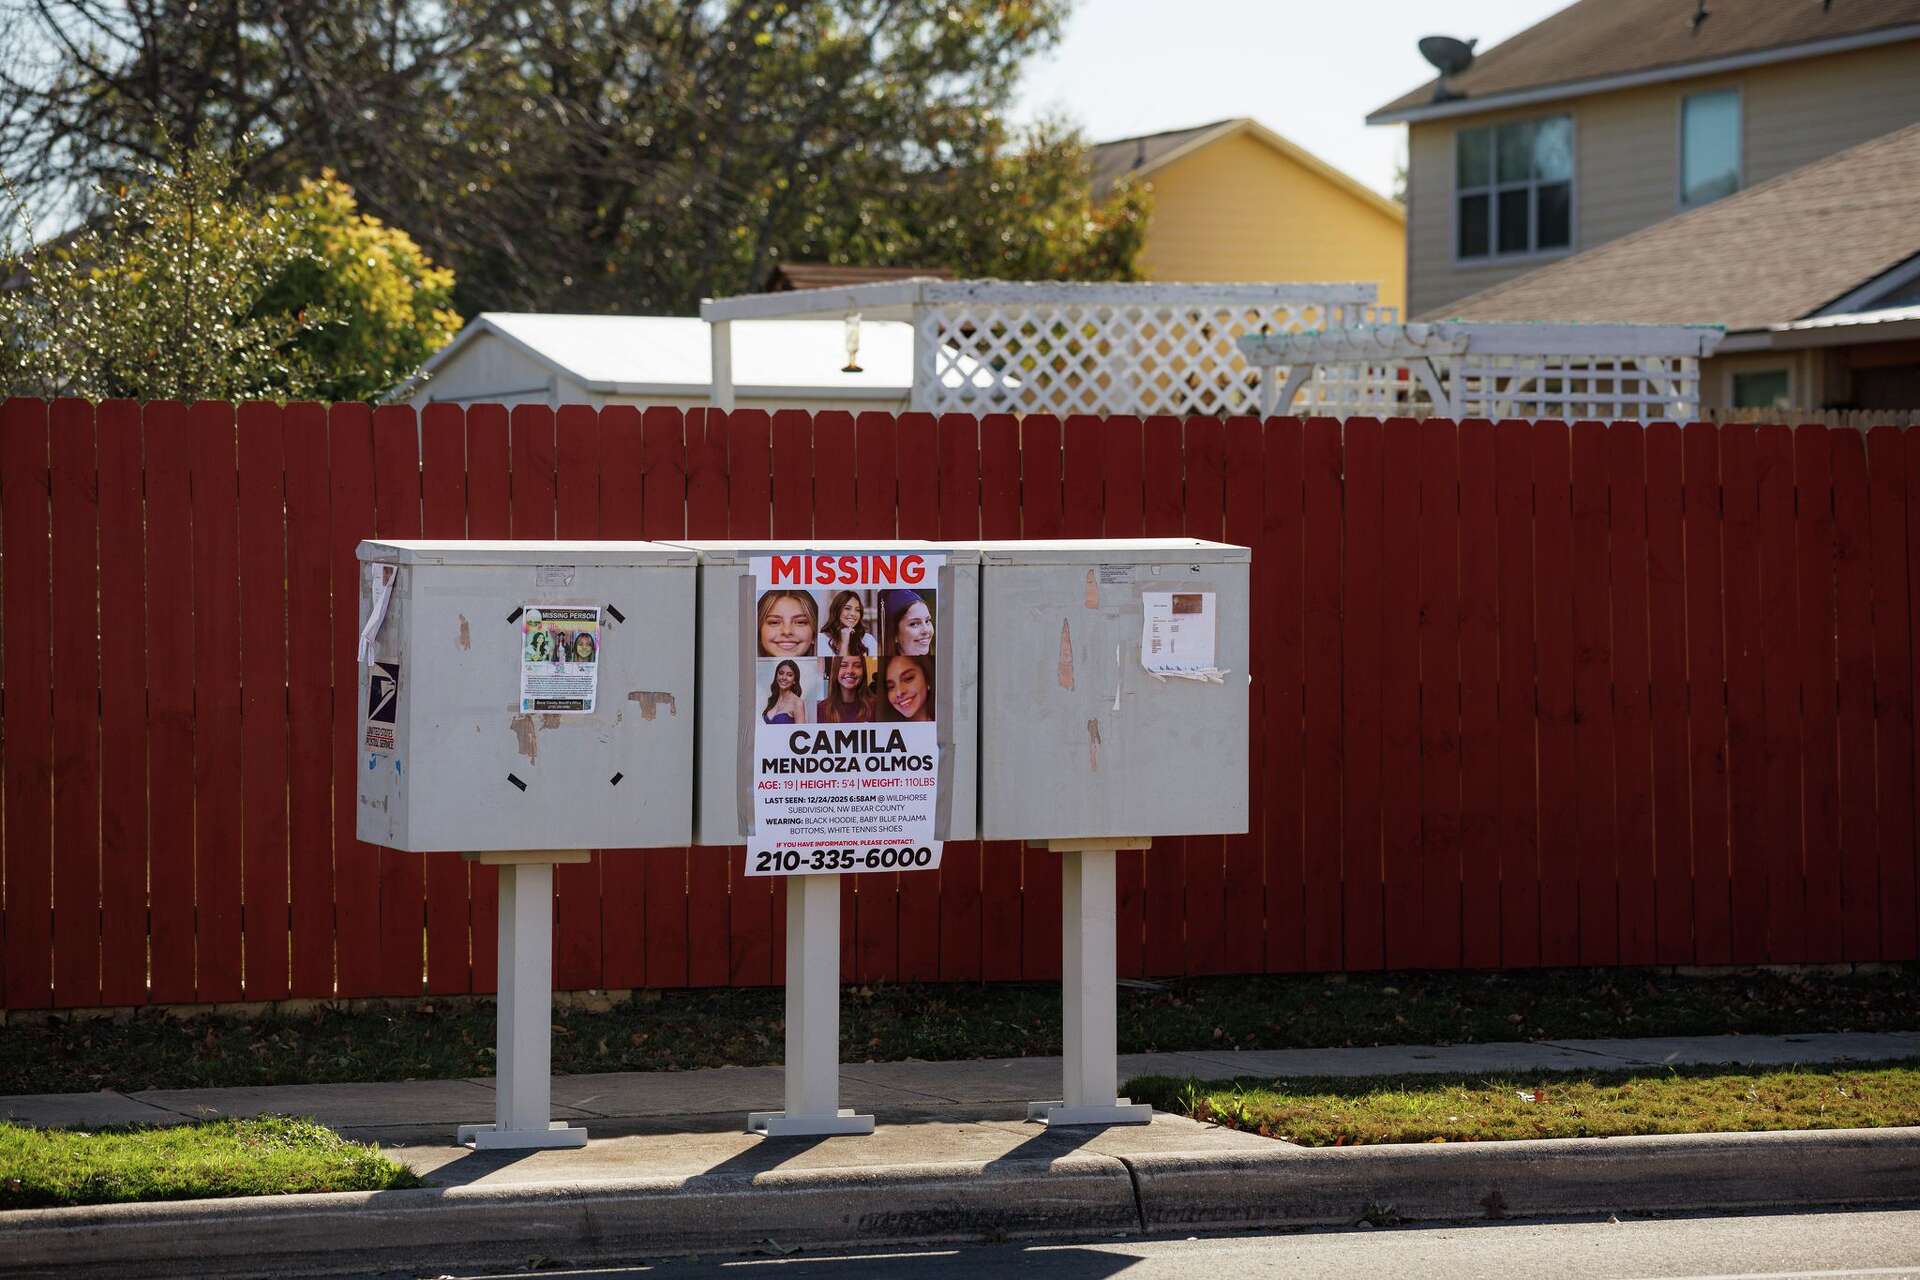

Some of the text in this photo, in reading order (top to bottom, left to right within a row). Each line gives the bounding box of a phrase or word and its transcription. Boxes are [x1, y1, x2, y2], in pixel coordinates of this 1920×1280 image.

[771, 554, 926, 585] MISSING
[789, 729, 908, 756] CAMILA
[761, 755, 933, 775] MENDOZA OLMOS
[758, 780, 781, 790] AGE:
[784, 780, 794, 790] 19
[800, 780, 840, 789] HEIGHT:
[862, 778, 903, 788] WEIGHT:
[905, 778, 936, 787] 110LBS
[878, 794, 886, 804] @
[756, 848, 932, 871] 210-335-6000
